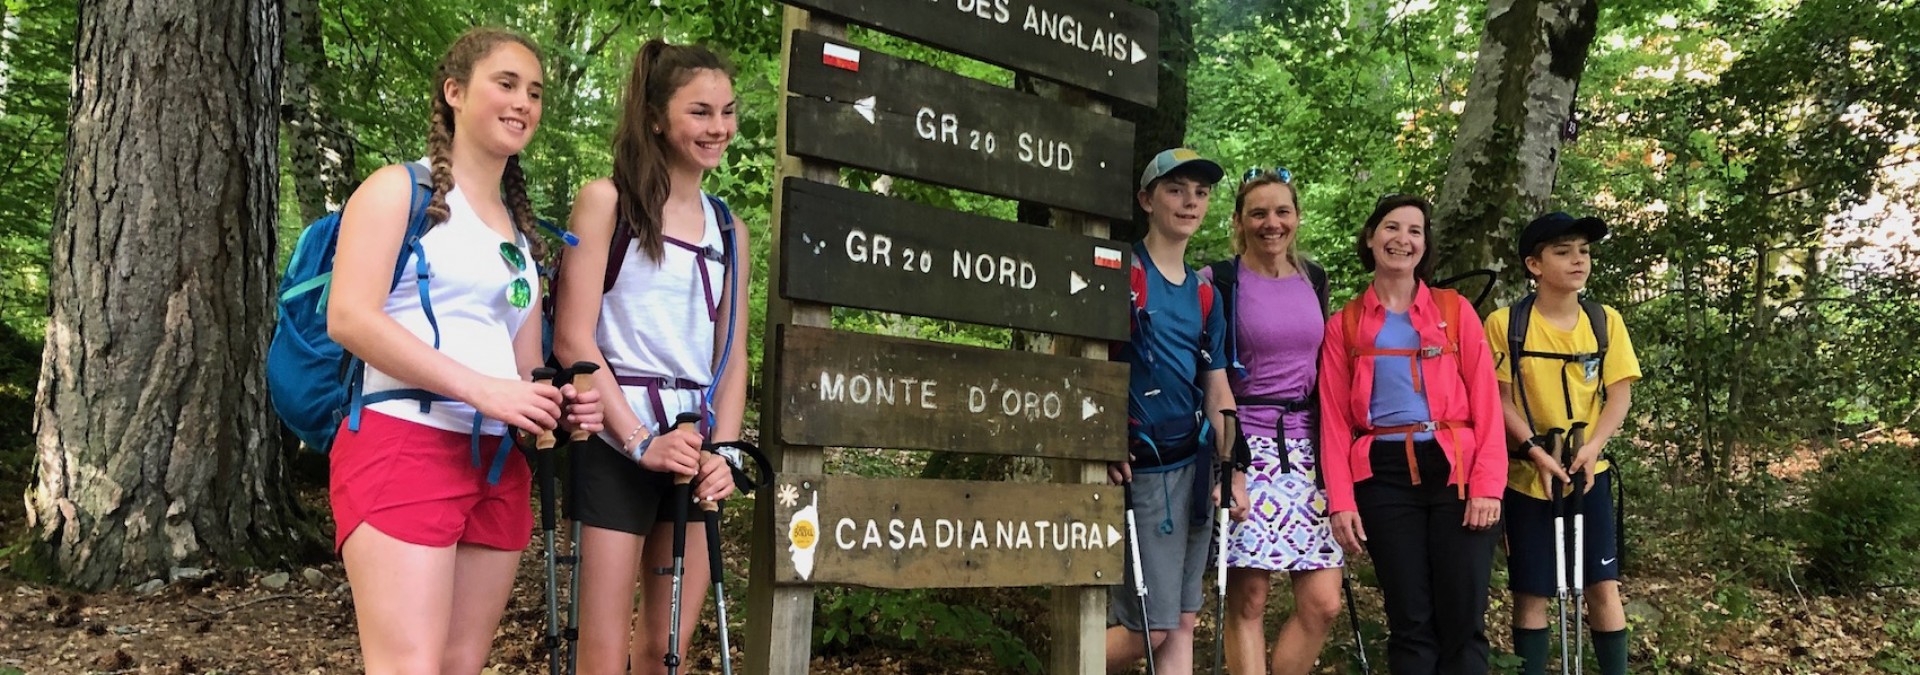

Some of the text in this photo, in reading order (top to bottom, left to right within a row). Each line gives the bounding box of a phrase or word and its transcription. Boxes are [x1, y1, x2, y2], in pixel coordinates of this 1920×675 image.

[1022, 5, 1128, 61] ANGLAIS
[915, 106, 1074, 171] GR 20 SUD
[845, 229, 1037, 290] GR 20 NORD
[819, 370, 1062, 419] MONTE D'ORO
[835, 517, 927, 550] CASA
[996, 520, 1104, 551] NATURA
